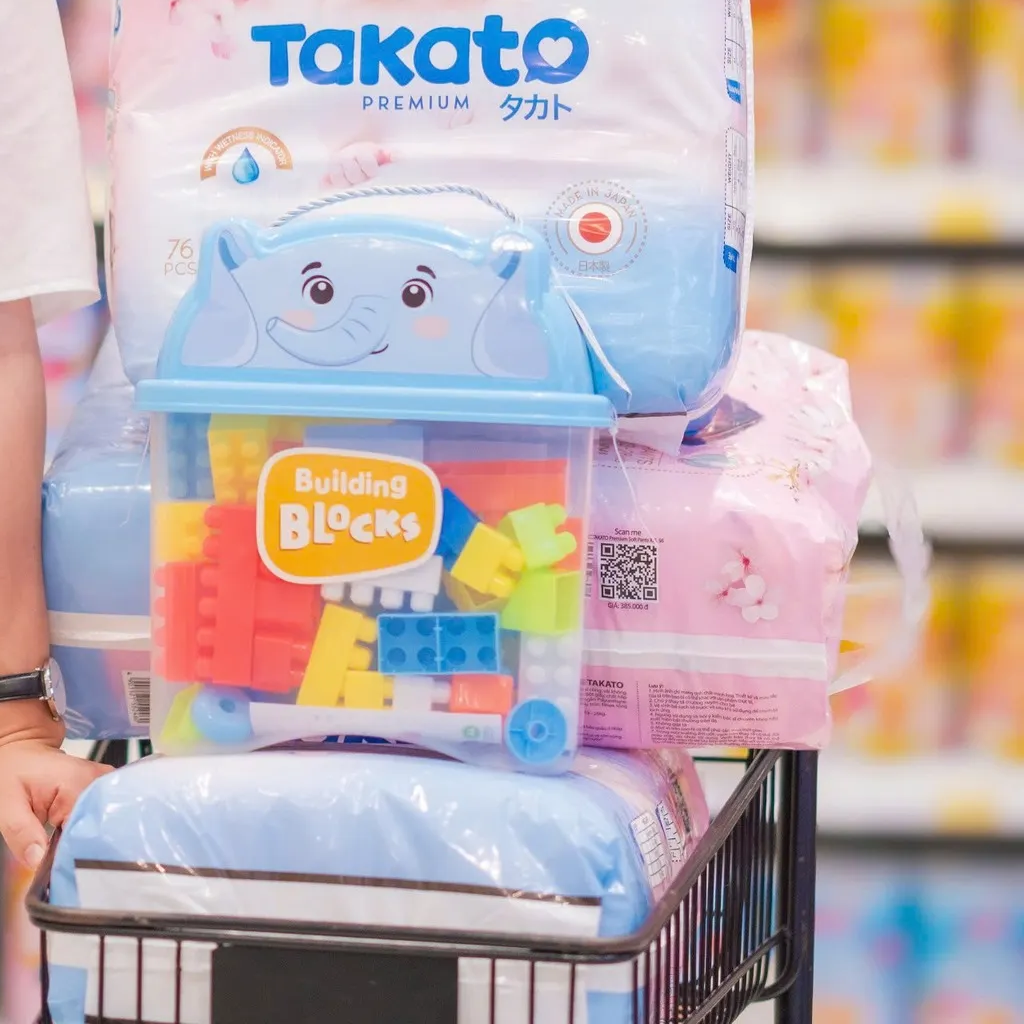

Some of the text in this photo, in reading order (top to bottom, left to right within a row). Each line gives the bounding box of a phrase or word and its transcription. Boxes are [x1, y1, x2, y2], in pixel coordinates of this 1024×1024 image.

[362, 95, 470, 111] PREMIUM
[499, 93, 573, 122] タカト
[554, 187, 638, 218] MADE IN JAPAN
[168, 238, 194, 260] 76
[164, 261, 197, 276] PCS
[578, 260, 610, 272] 日本製
[295, 467, 408, 499] Building
[614, 528, 630, 536] Scan
[586, 678, 624, 689] TAKATO
